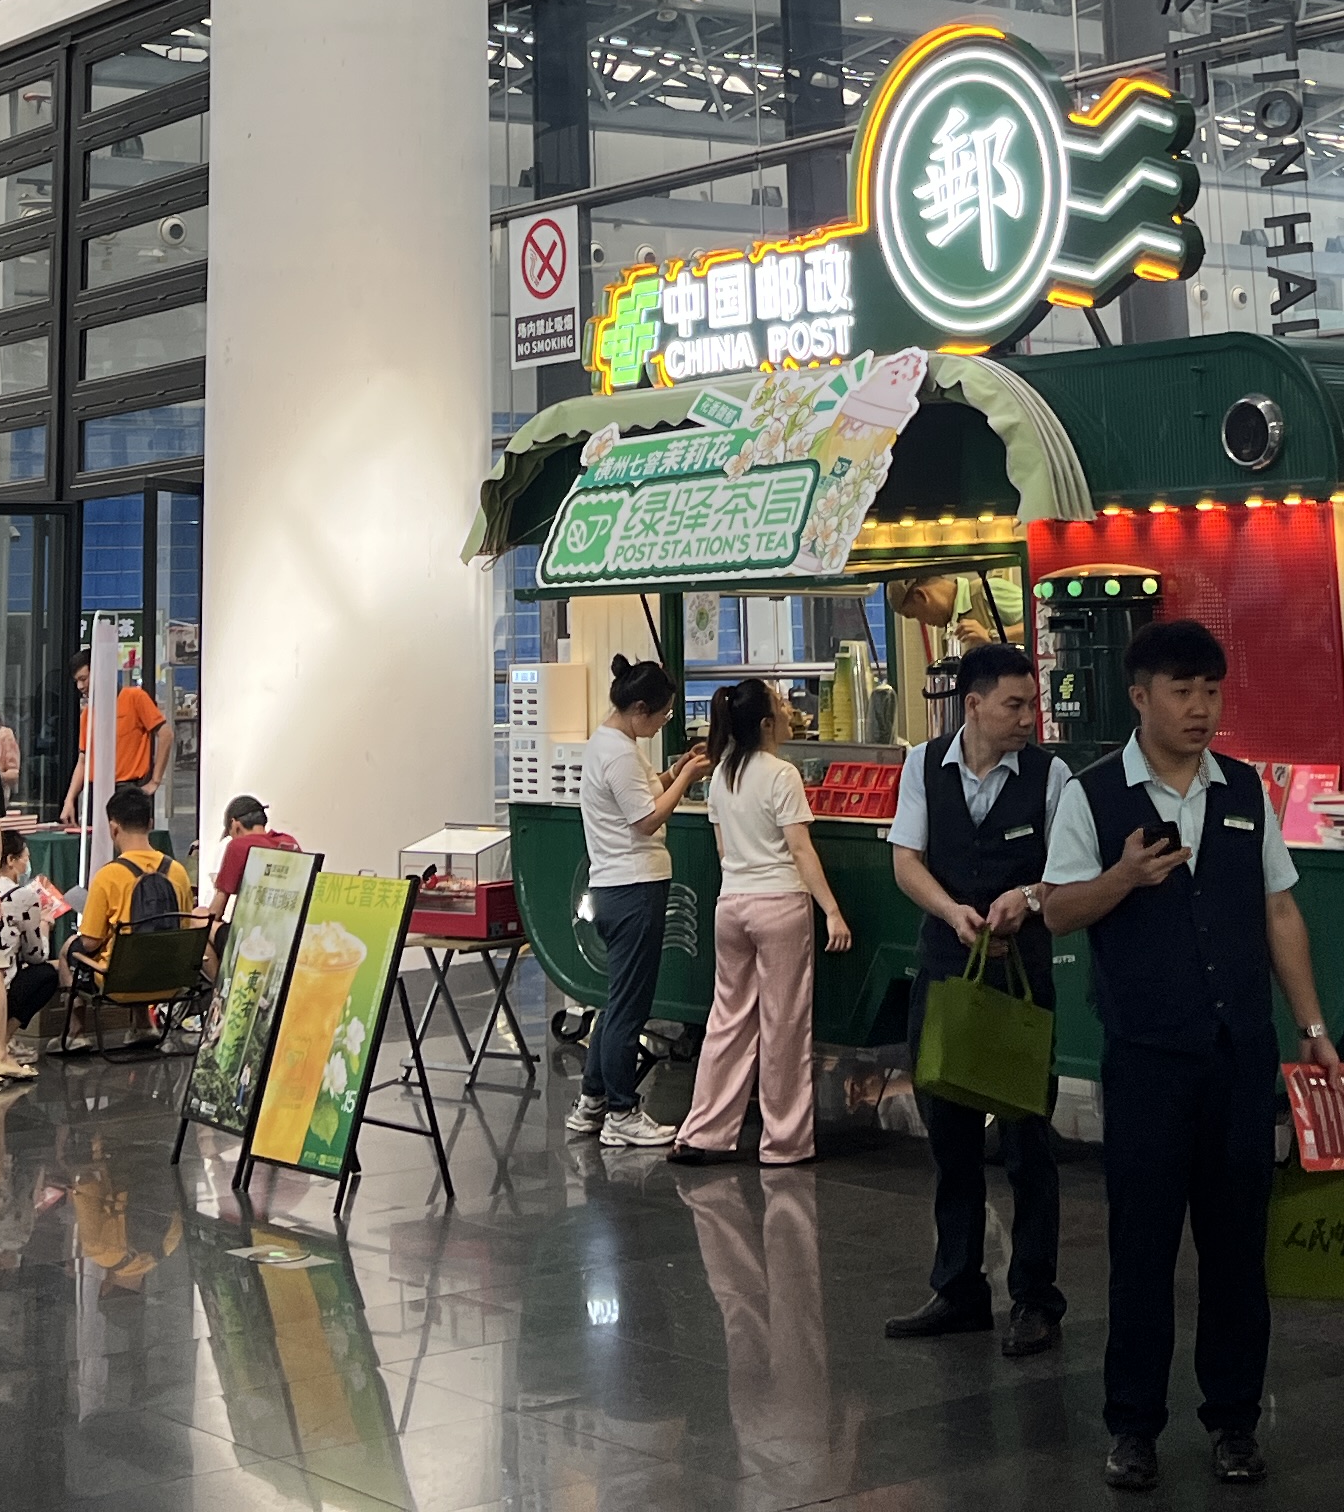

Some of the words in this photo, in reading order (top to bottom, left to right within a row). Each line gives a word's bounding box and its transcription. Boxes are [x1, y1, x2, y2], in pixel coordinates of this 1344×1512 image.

[912, 106, 1025, 272] 郵
[662, 244, 853, 338] 中国邮政
[1263, 211, 1320, 337] HAL
[516, 315, 573, 339] 场内禁止吸烟
[517, 340, 531, 357] NO
[533, 336, 574, 355] SMOKING
[663, 331, 757, 379] CHINA
[766, 315, 855, 364] POST
[613, 541, 656, 565] POST
[658, 535, 750, 560] STATION'S
[754, 530, 788, 552] TEA
